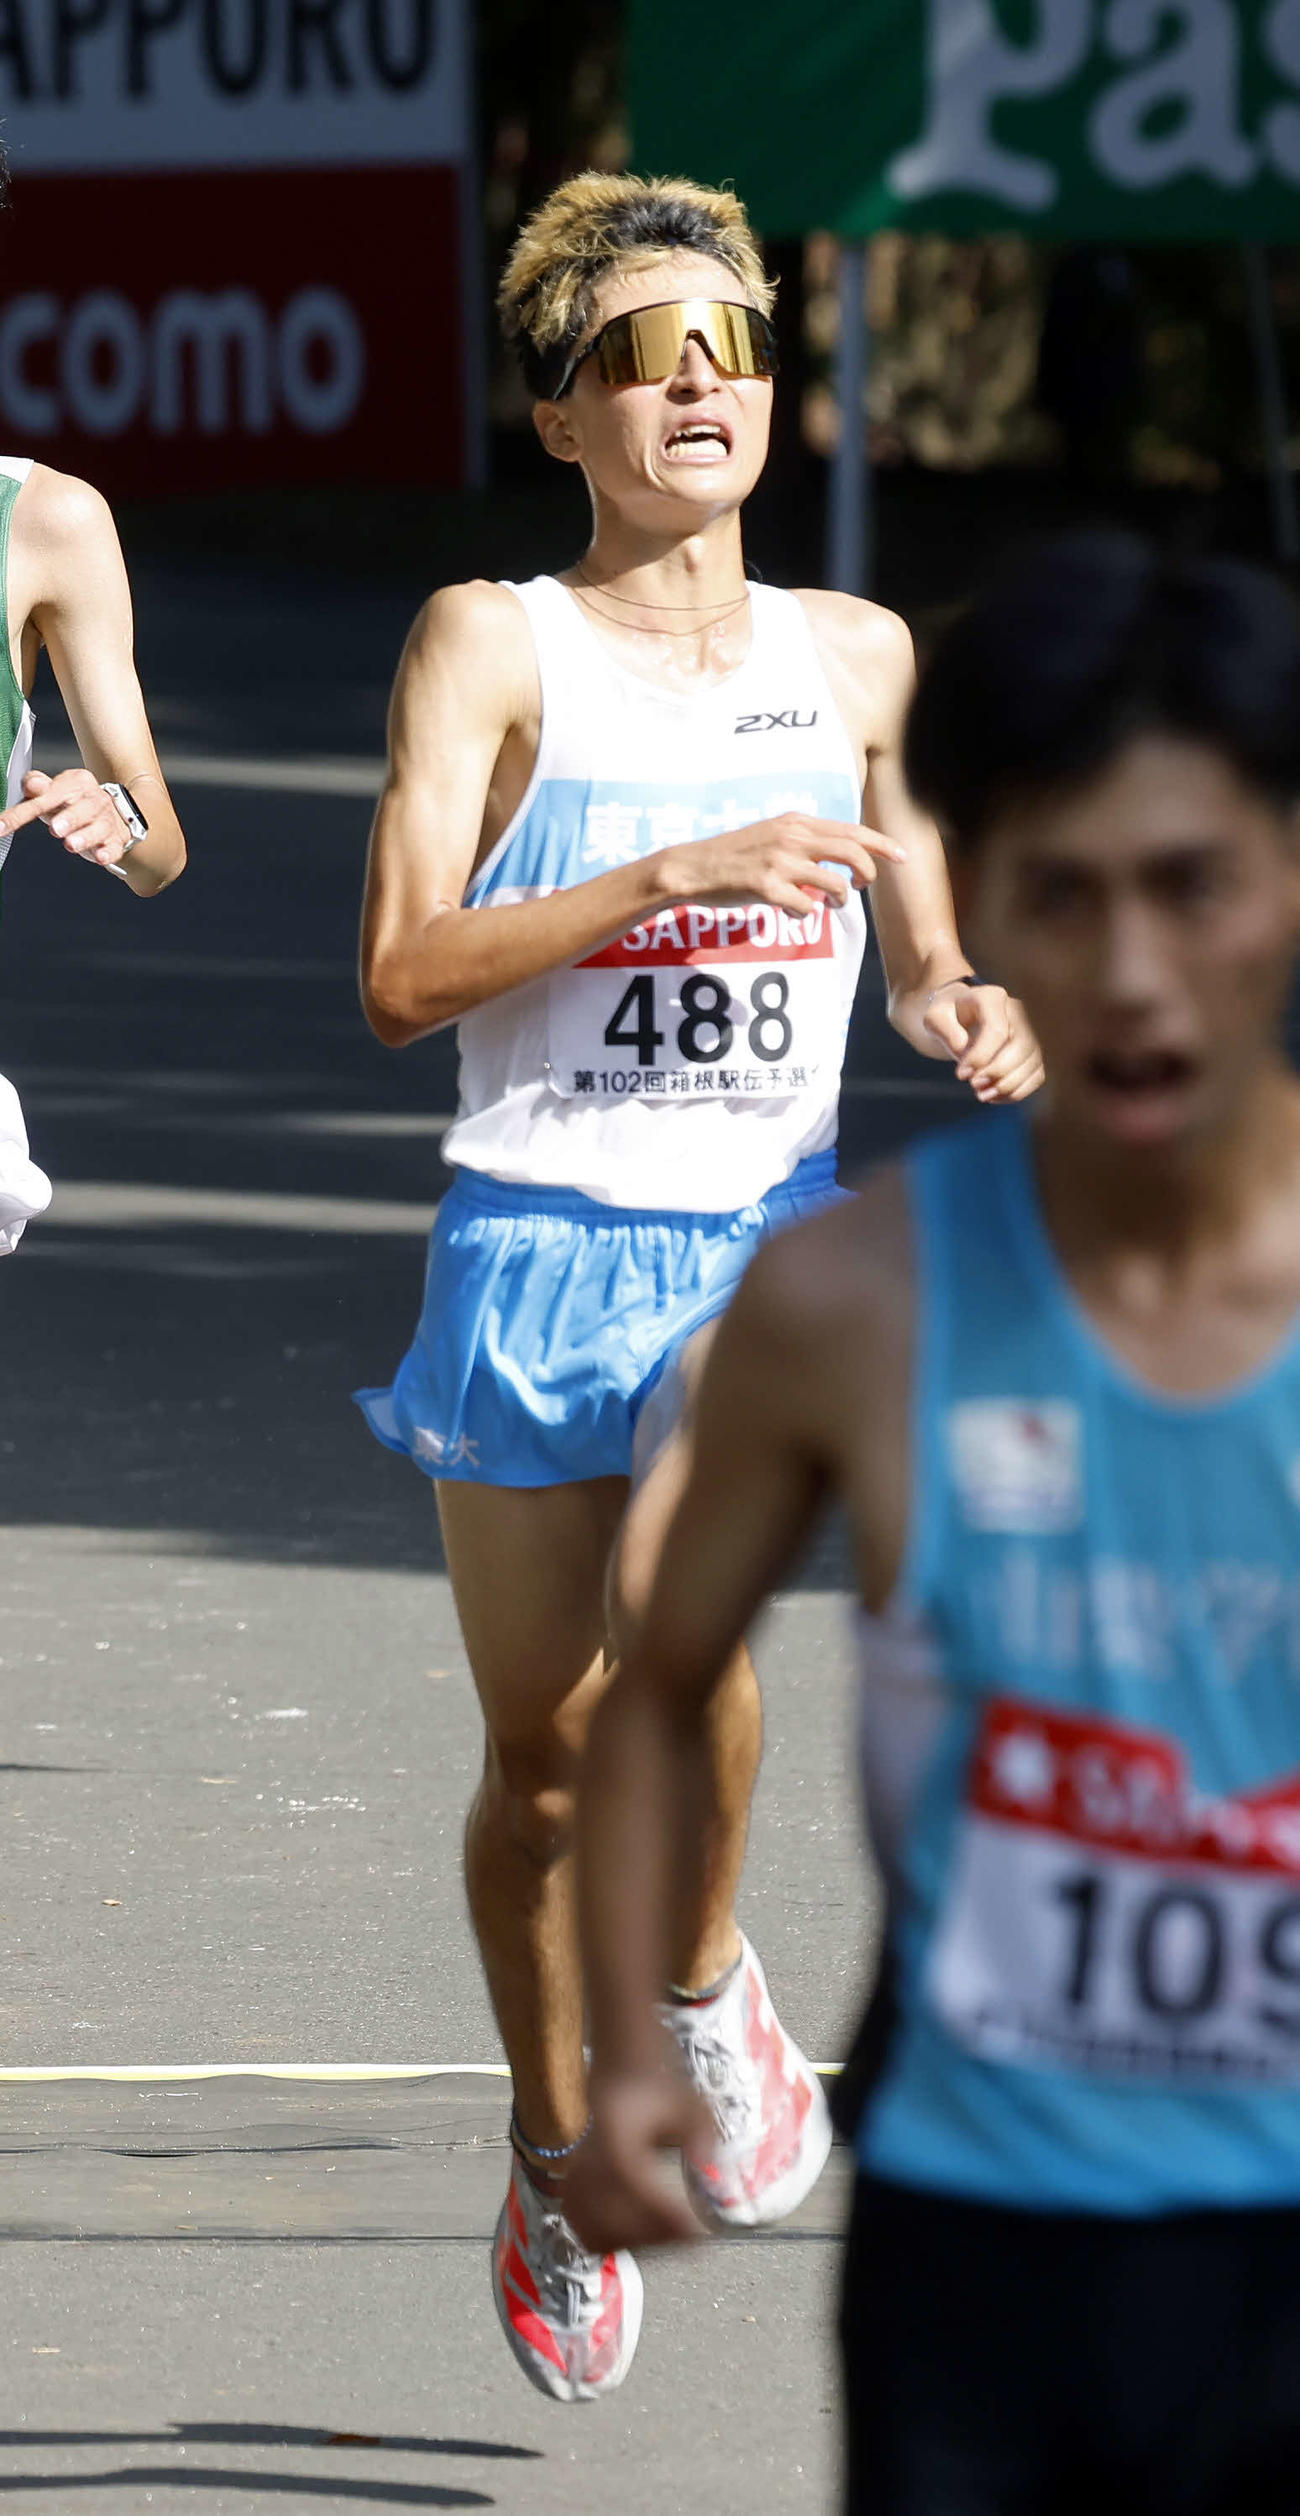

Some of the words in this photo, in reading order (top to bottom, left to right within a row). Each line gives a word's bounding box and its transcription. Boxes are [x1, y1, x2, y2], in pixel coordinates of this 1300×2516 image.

[604, 971, 793, 1067] 488
[573, 1064, 819, 1094] 第102回箱根駅伝予選
